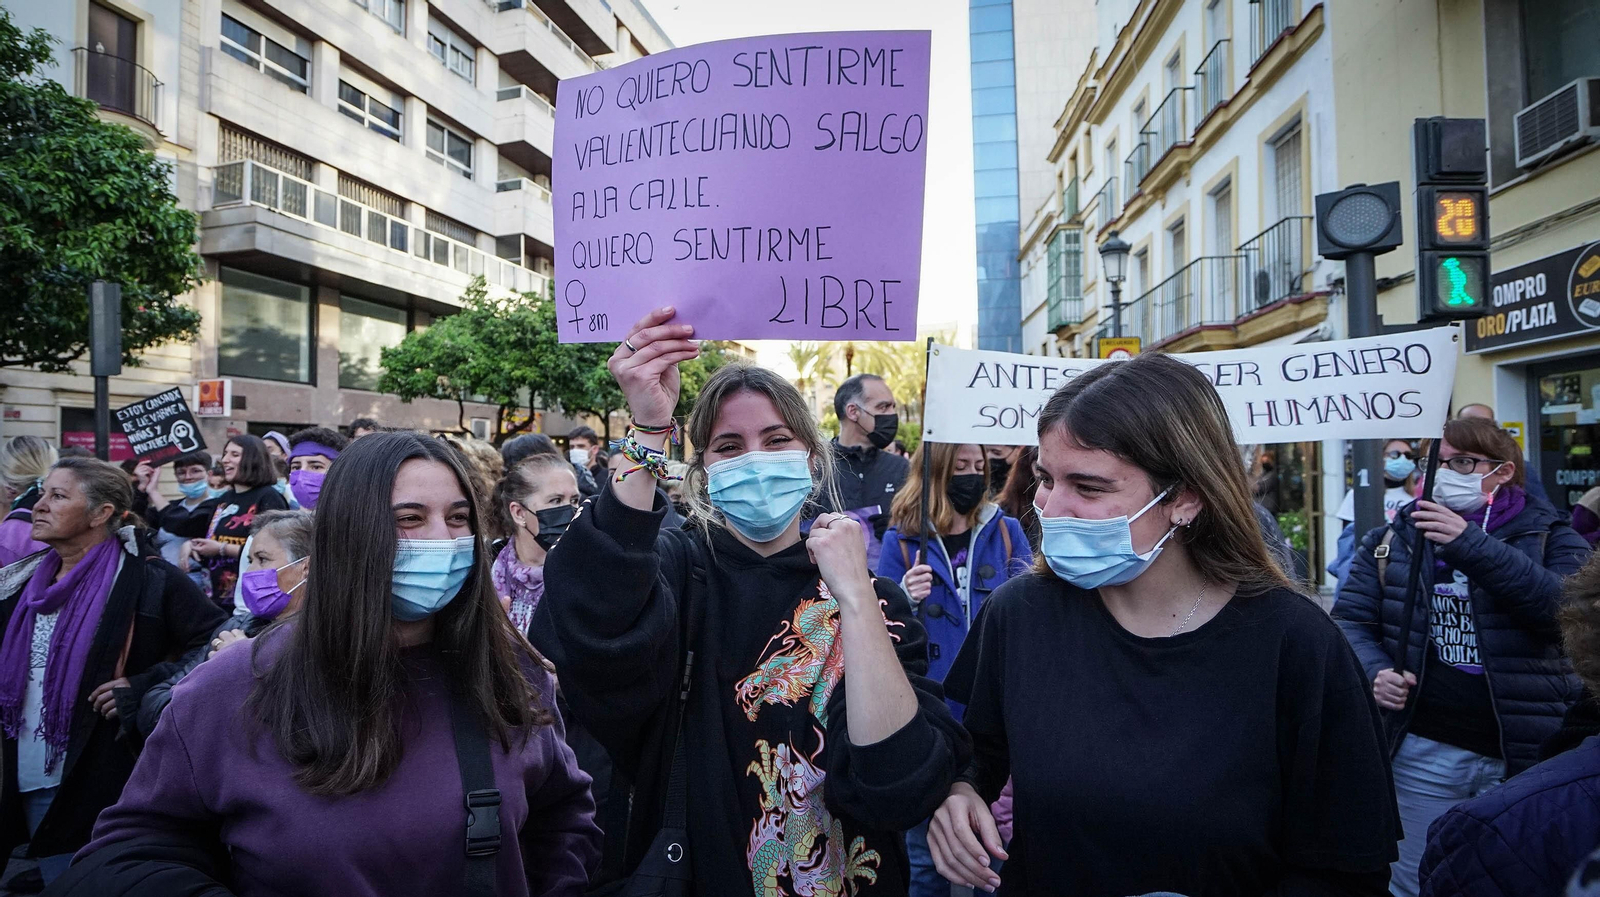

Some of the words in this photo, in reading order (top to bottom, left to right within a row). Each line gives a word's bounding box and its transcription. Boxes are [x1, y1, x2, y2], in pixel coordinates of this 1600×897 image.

[574, 85, 605, 120] NO
[616, 59, 711, 111] QUIERO
[733, 46, 904, 88] SENTIRME
[815, 111, 923, 154] SALGO
[572, 191, 585, 222] A
[593, 186, 618, 219] LA
[629, 176, 719, 211] CALLE.
[1438, 198, 1475, 236] 20
[572, 231, 654, 270] QUIERO
[673, 226, 833, 263] SENTIRME
[769, 275, 901, 331] LIBRE
[1493, 272, 1546, 308] OMPRO
[1477, 301, 1557, 339] ORO/PLATA
[1280, 343, 1432, 383] GENERO
[116, 404, 145, 421] ESTOY
[145, 389, 182, 411] CANSADX
[122, 420, 136, 433] DE
[177, 402, 187, 413] A
[1246, 391, 1423, 428] HUMANOS
[127, 427, 154, 444] NIÑAS
[154, 425, 162, 436] Y
[133, 434, 168, 455] MUJERES
[1357, 468, 1371, 488] 1
[1442, 644, 1482, 664] QUEM
[1444, 626, 1461, 645] NO
